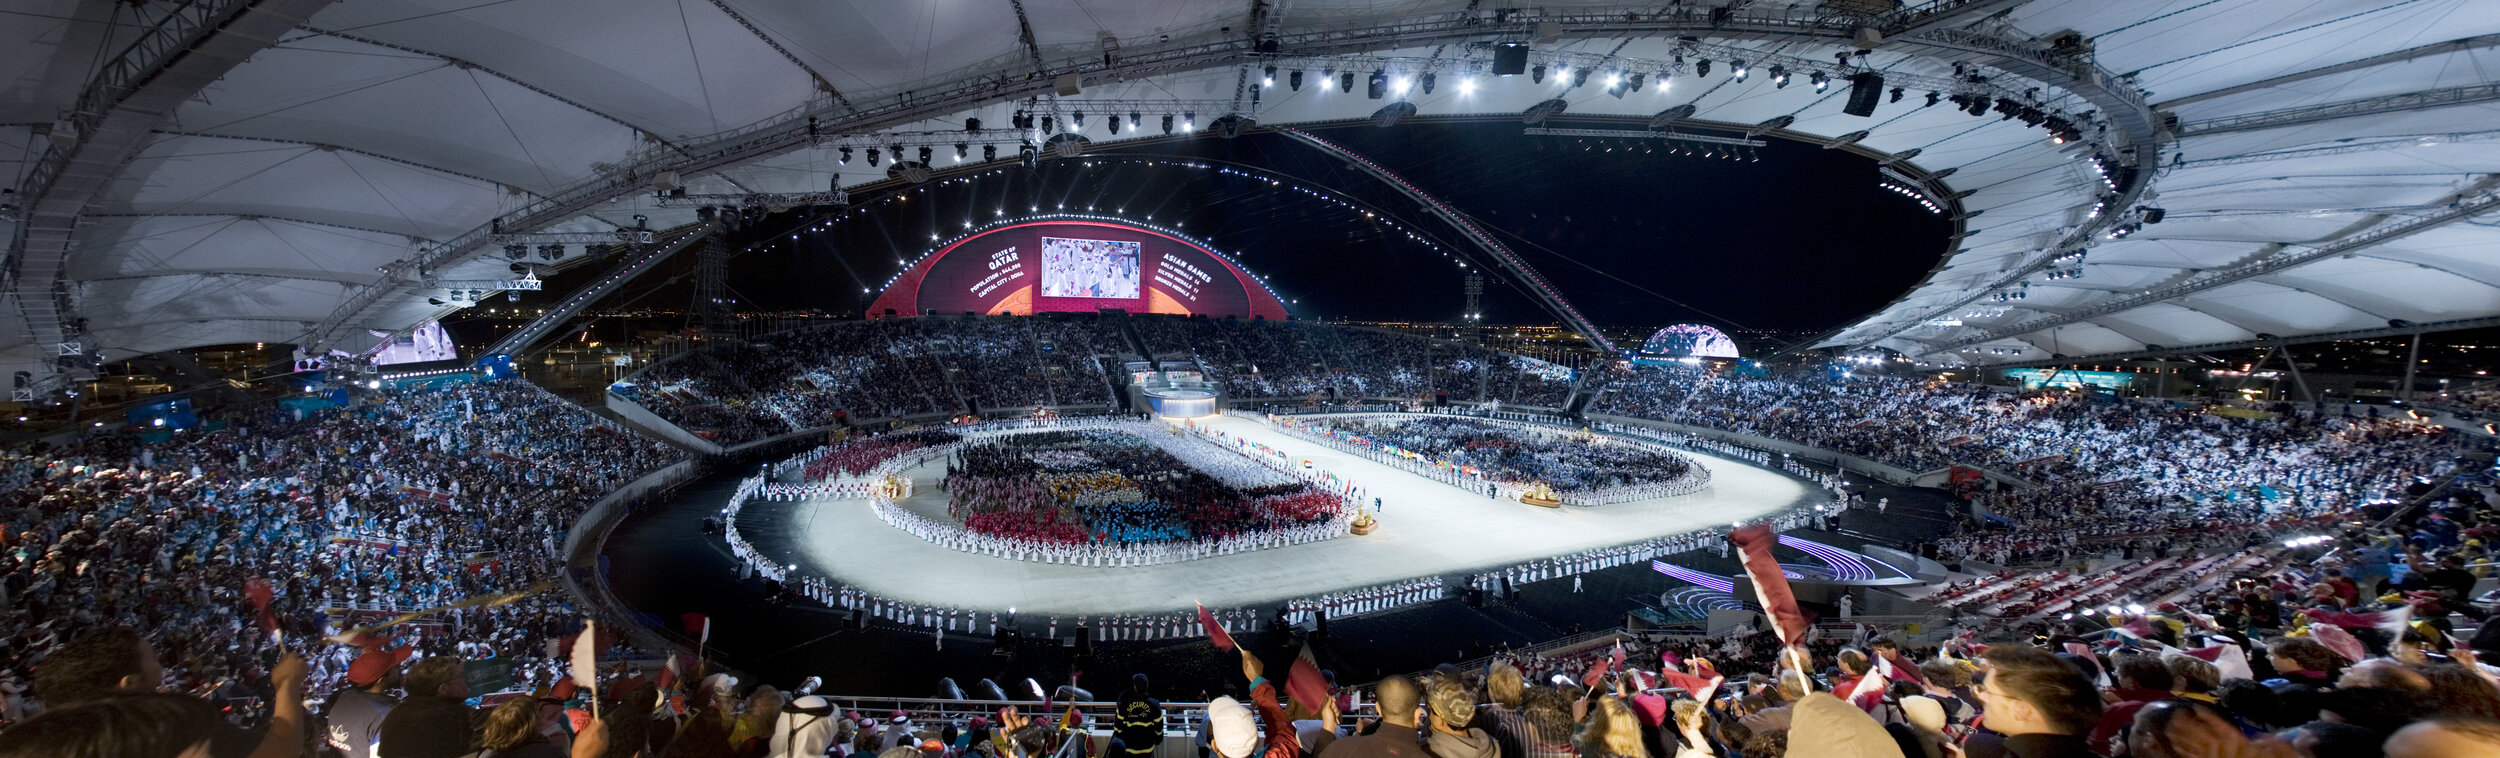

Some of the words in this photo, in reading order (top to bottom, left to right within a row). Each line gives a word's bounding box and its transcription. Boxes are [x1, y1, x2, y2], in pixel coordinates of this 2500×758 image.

[988, 252, 1019, 270] QATAR
[992, 249, 1008, 260] STATE
[1160, 262, 1174, 270] GOLD
[1173, 266, 1194, 281] MEDALS
[1163, 252, 1187, 268] ASIAN
[1187, 264, 1212, 283] GAMES
[970, 272, 999, 292] POPULATION
[978, 284, 998, 298] CAPITAL
[997, 277, 1008, 286] CITY
[1011, 271, 1024, 280] DOHA
[1154, 276, 1172, 288] BRONZE
[1172, 284, 1190, 297] MEDALS
[1158, 268, 1174, 280] SILVER
[1174, 274, 1192, 290] MEDALS
[1126, 701, 1150, 712] SECURITY
